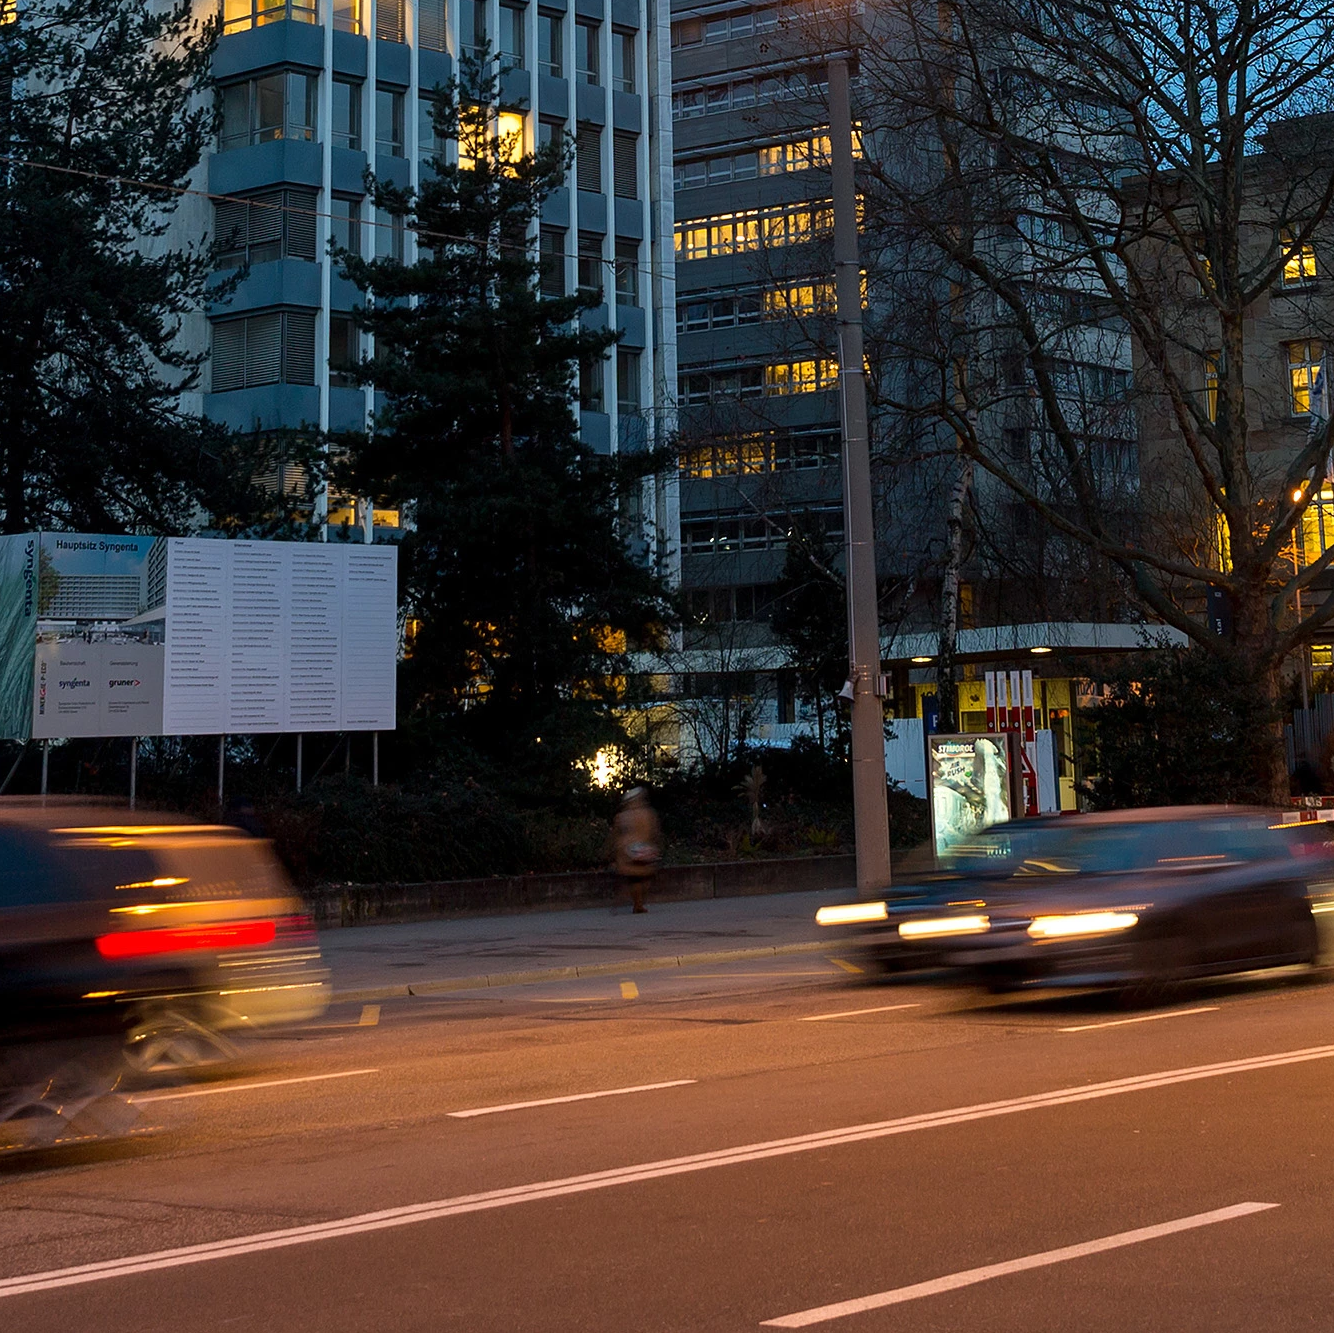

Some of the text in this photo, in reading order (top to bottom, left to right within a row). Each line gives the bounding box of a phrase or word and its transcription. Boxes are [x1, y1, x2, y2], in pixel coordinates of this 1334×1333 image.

[56, 539, 139, 554] Hauptsitz Syngenta
[23, 539, 35, 617] syngenta
[58, 678, 91, 689] syngenta
[108, 679, 134, 688] gruner
